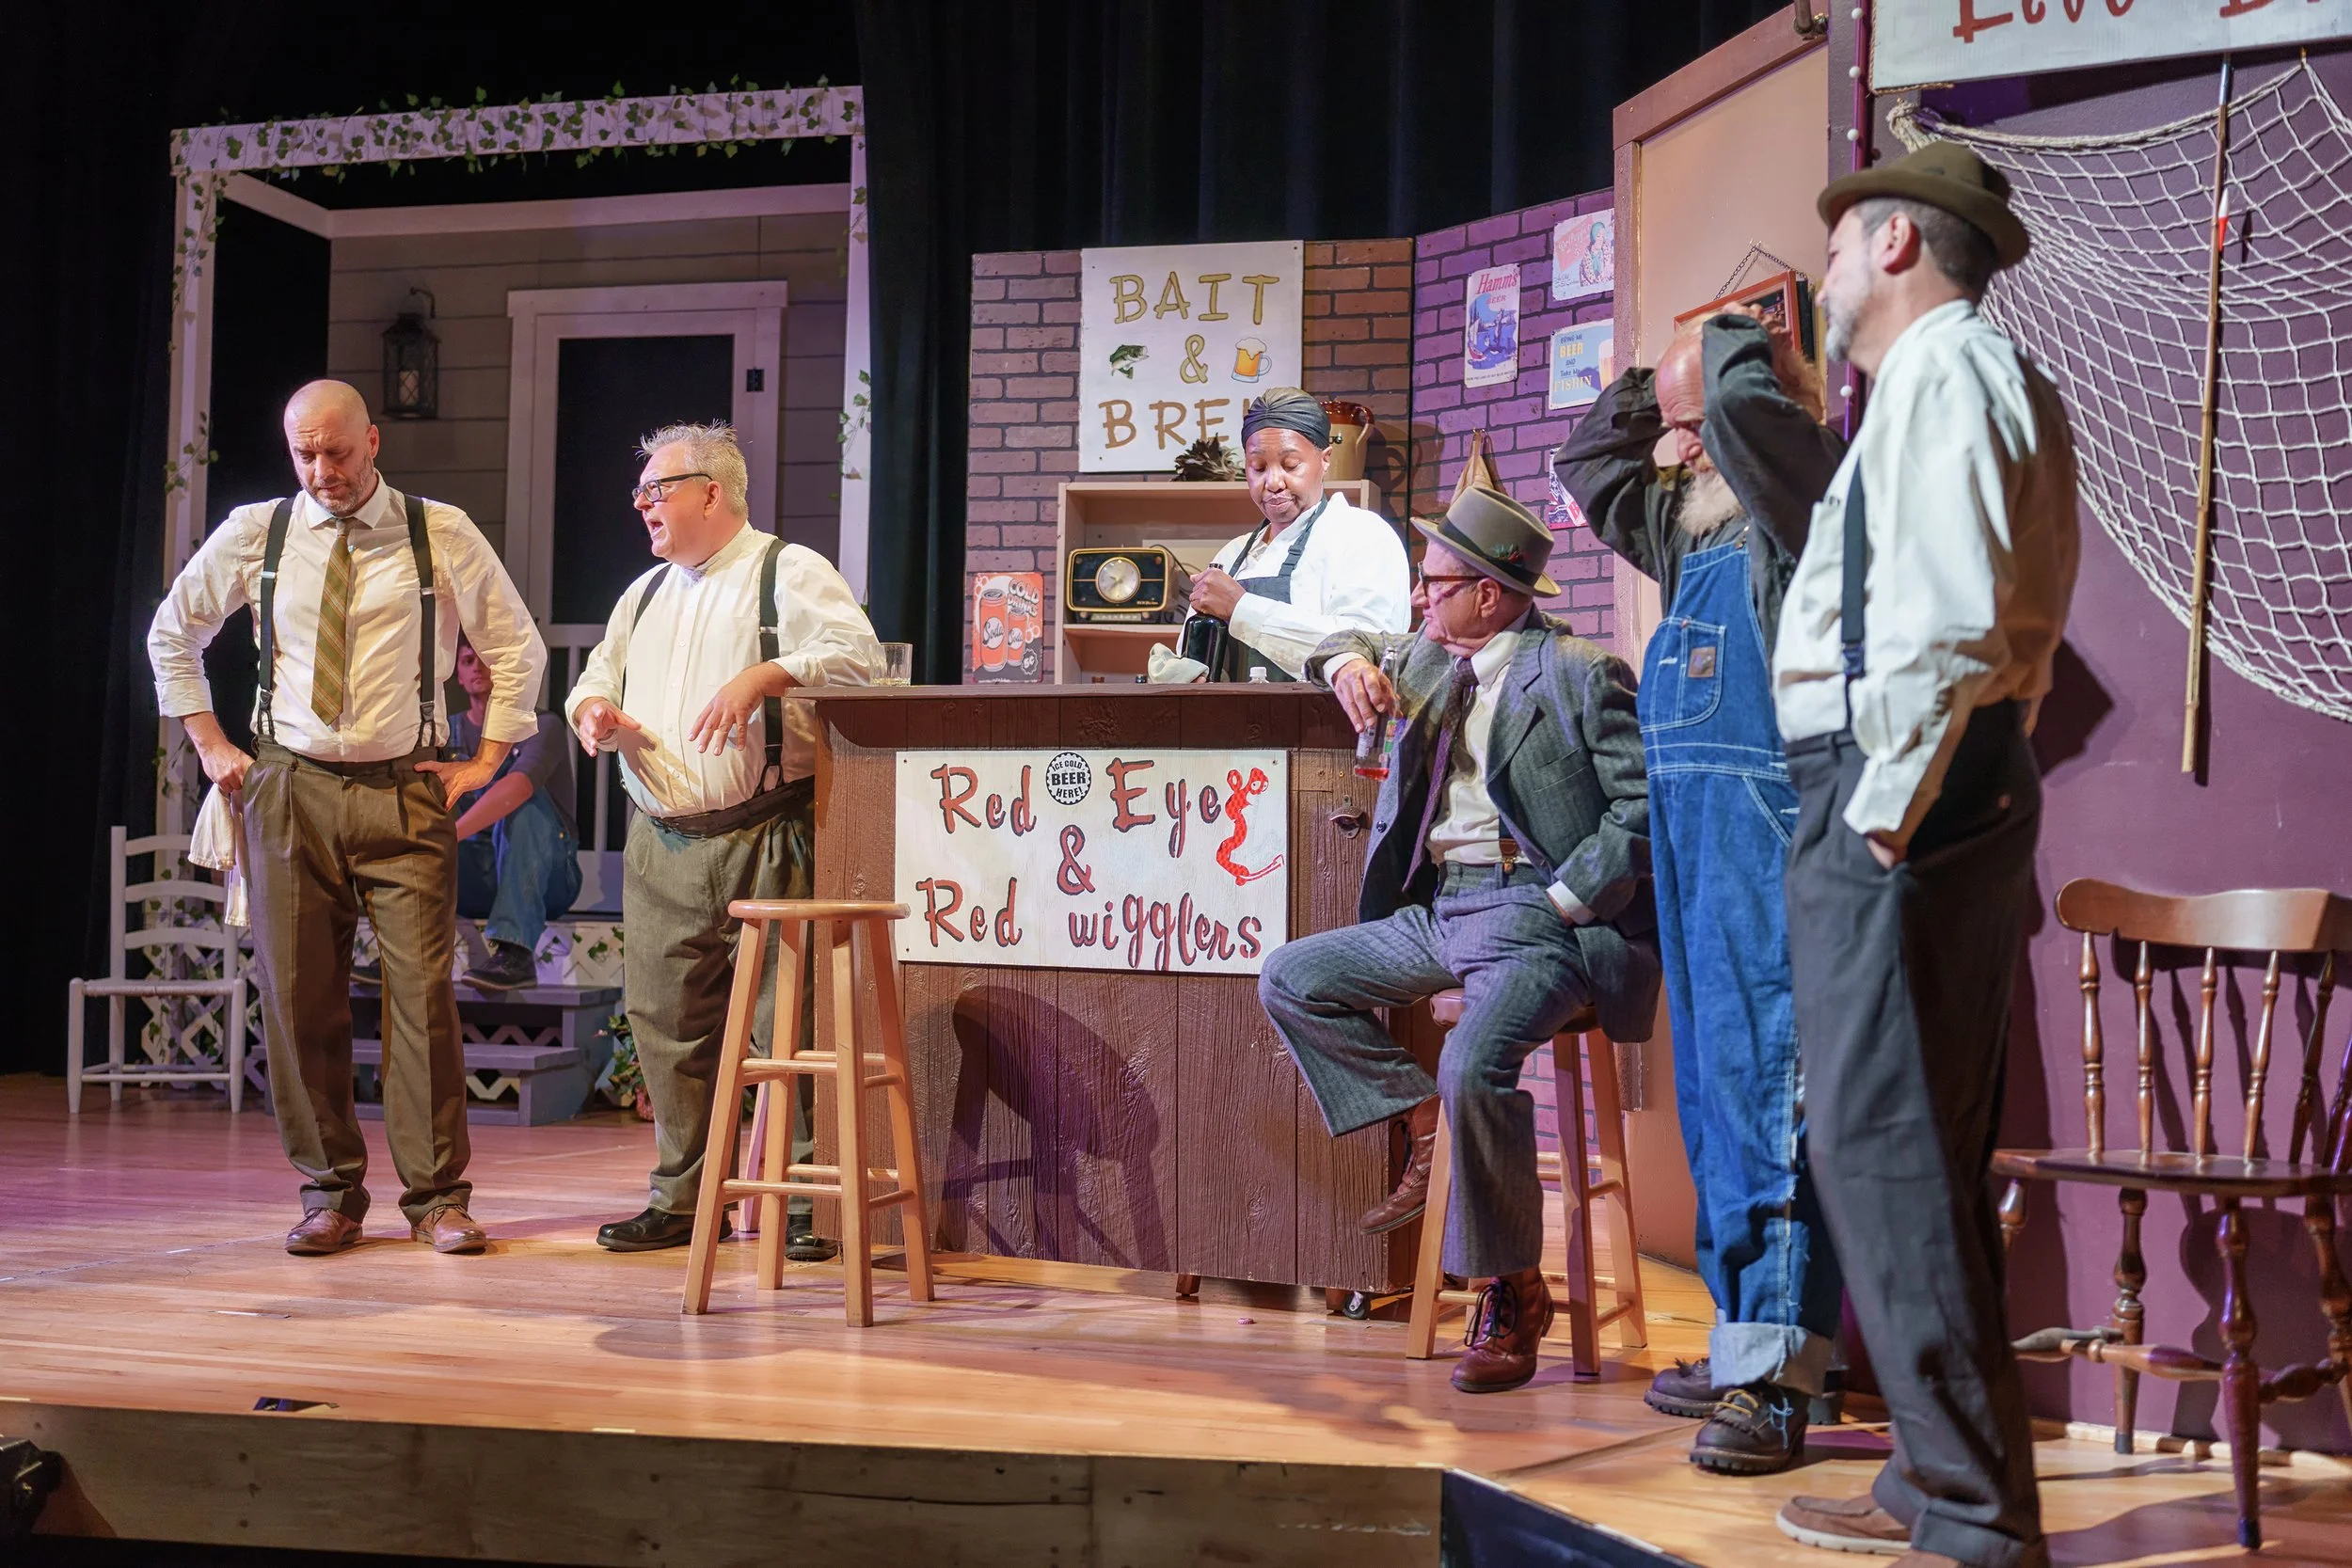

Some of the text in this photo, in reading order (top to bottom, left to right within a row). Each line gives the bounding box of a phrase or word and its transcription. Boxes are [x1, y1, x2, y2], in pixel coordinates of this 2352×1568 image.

[1476, 269, 1519, 294] Hamm's
[1109, 271, 1279, 325] BAIT
[1487, 294, 1506, 304] BEER
[1180, 334, 1208, 384] &
[1560, 342, 1582, 358] BEER
[1099, 399, 1250, 450] BRE
[1009, 578, 1040, 604] COLD
[1008, 594, 1038, 616] DRINKS
[983, 622, 1003, 644] Soda
[1008, 630, 1023, 645] Soda
[1052, 760, 1083, 771] ICE COLD
[1051, 771, 1087, 785] BEER
[1056, 786, 1084, 799] HERE!
[930, 757, 1221, 858] Red Eye
[1057, 824, 1096, 895] &
[915, 876, 1263, 971] Red wigglers
